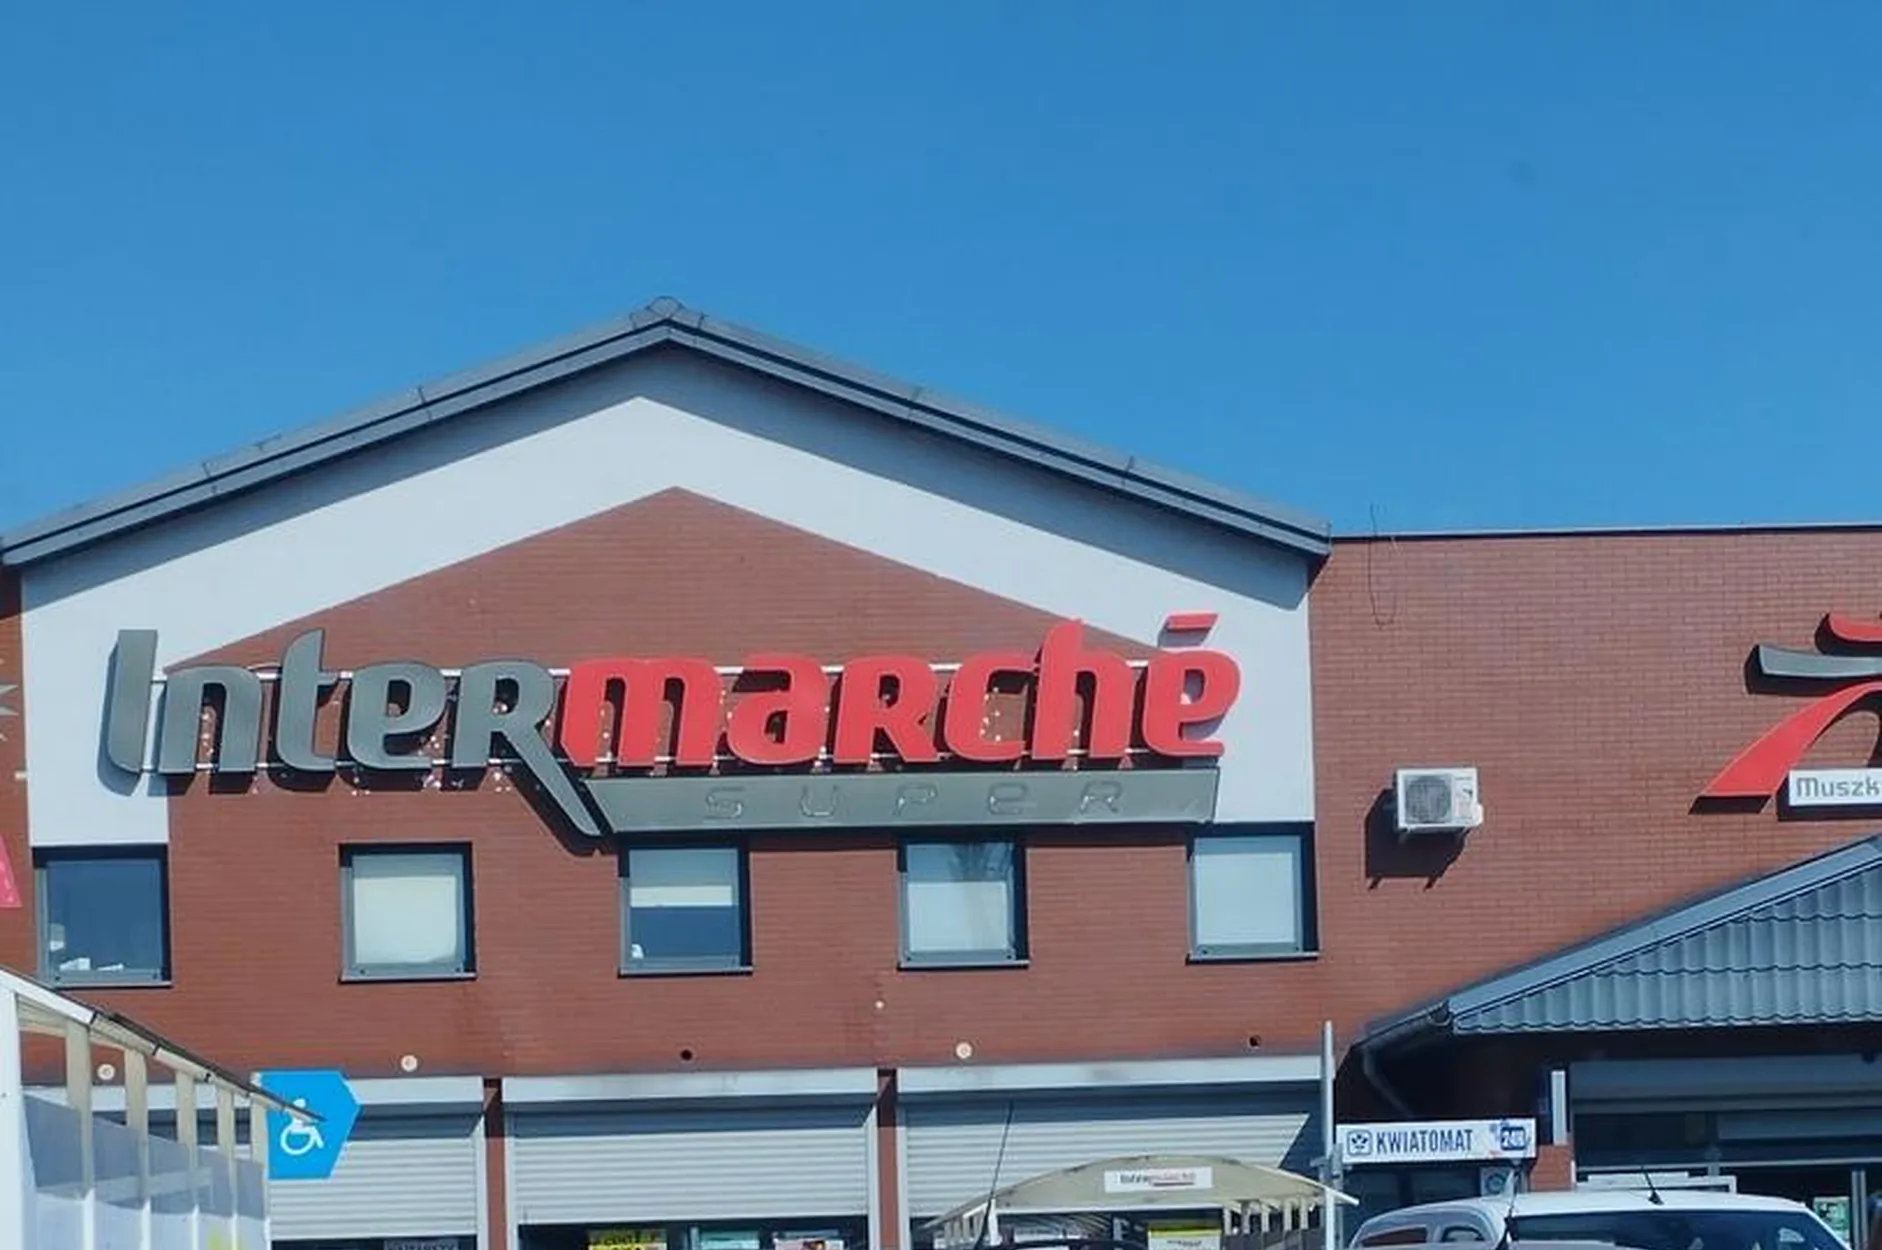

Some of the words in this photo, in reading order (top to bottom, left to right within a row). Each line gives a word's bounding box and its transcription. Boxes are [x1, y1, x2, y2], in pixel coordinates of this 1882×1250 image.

[104, 612, 1241, 837] Intermarché
[704, 779, 1125, 821] SUPER
[1376, 1129, 1473, 1154] KWIATOMAT
